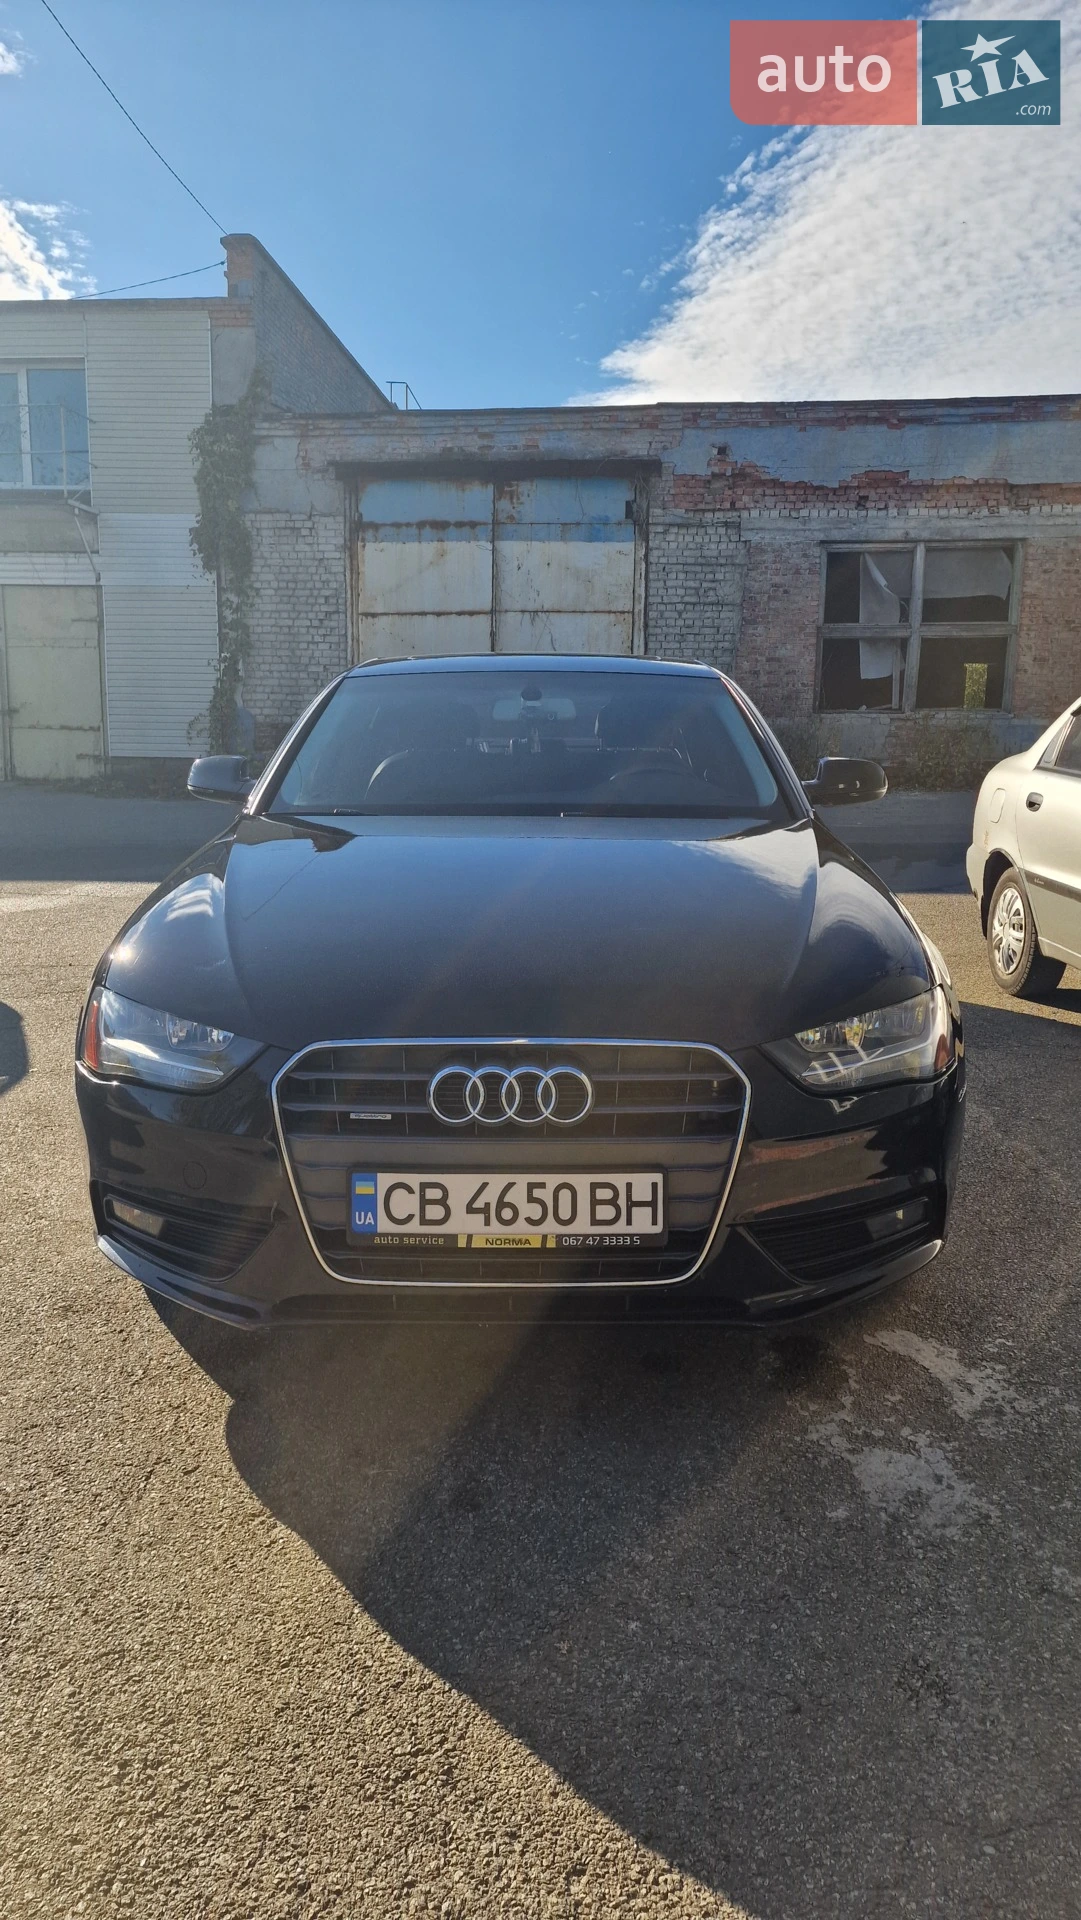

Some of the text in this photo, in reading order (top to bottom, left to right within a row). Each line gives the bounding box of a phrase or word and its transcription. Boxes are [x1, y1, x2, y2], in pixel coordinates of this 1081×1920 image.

[383, 1181, 658, 1227] CB 4650 BH
[355, 1211, 375, 1225] UA
[374, 1235, 444, 1245] auto service
[485, 1238, 532, 1246] NORMA
[562, 1236, 583, 1246] 067
[586, 1236, 600, 1245] 47
[602, 1236, 631, 1245] 3333
